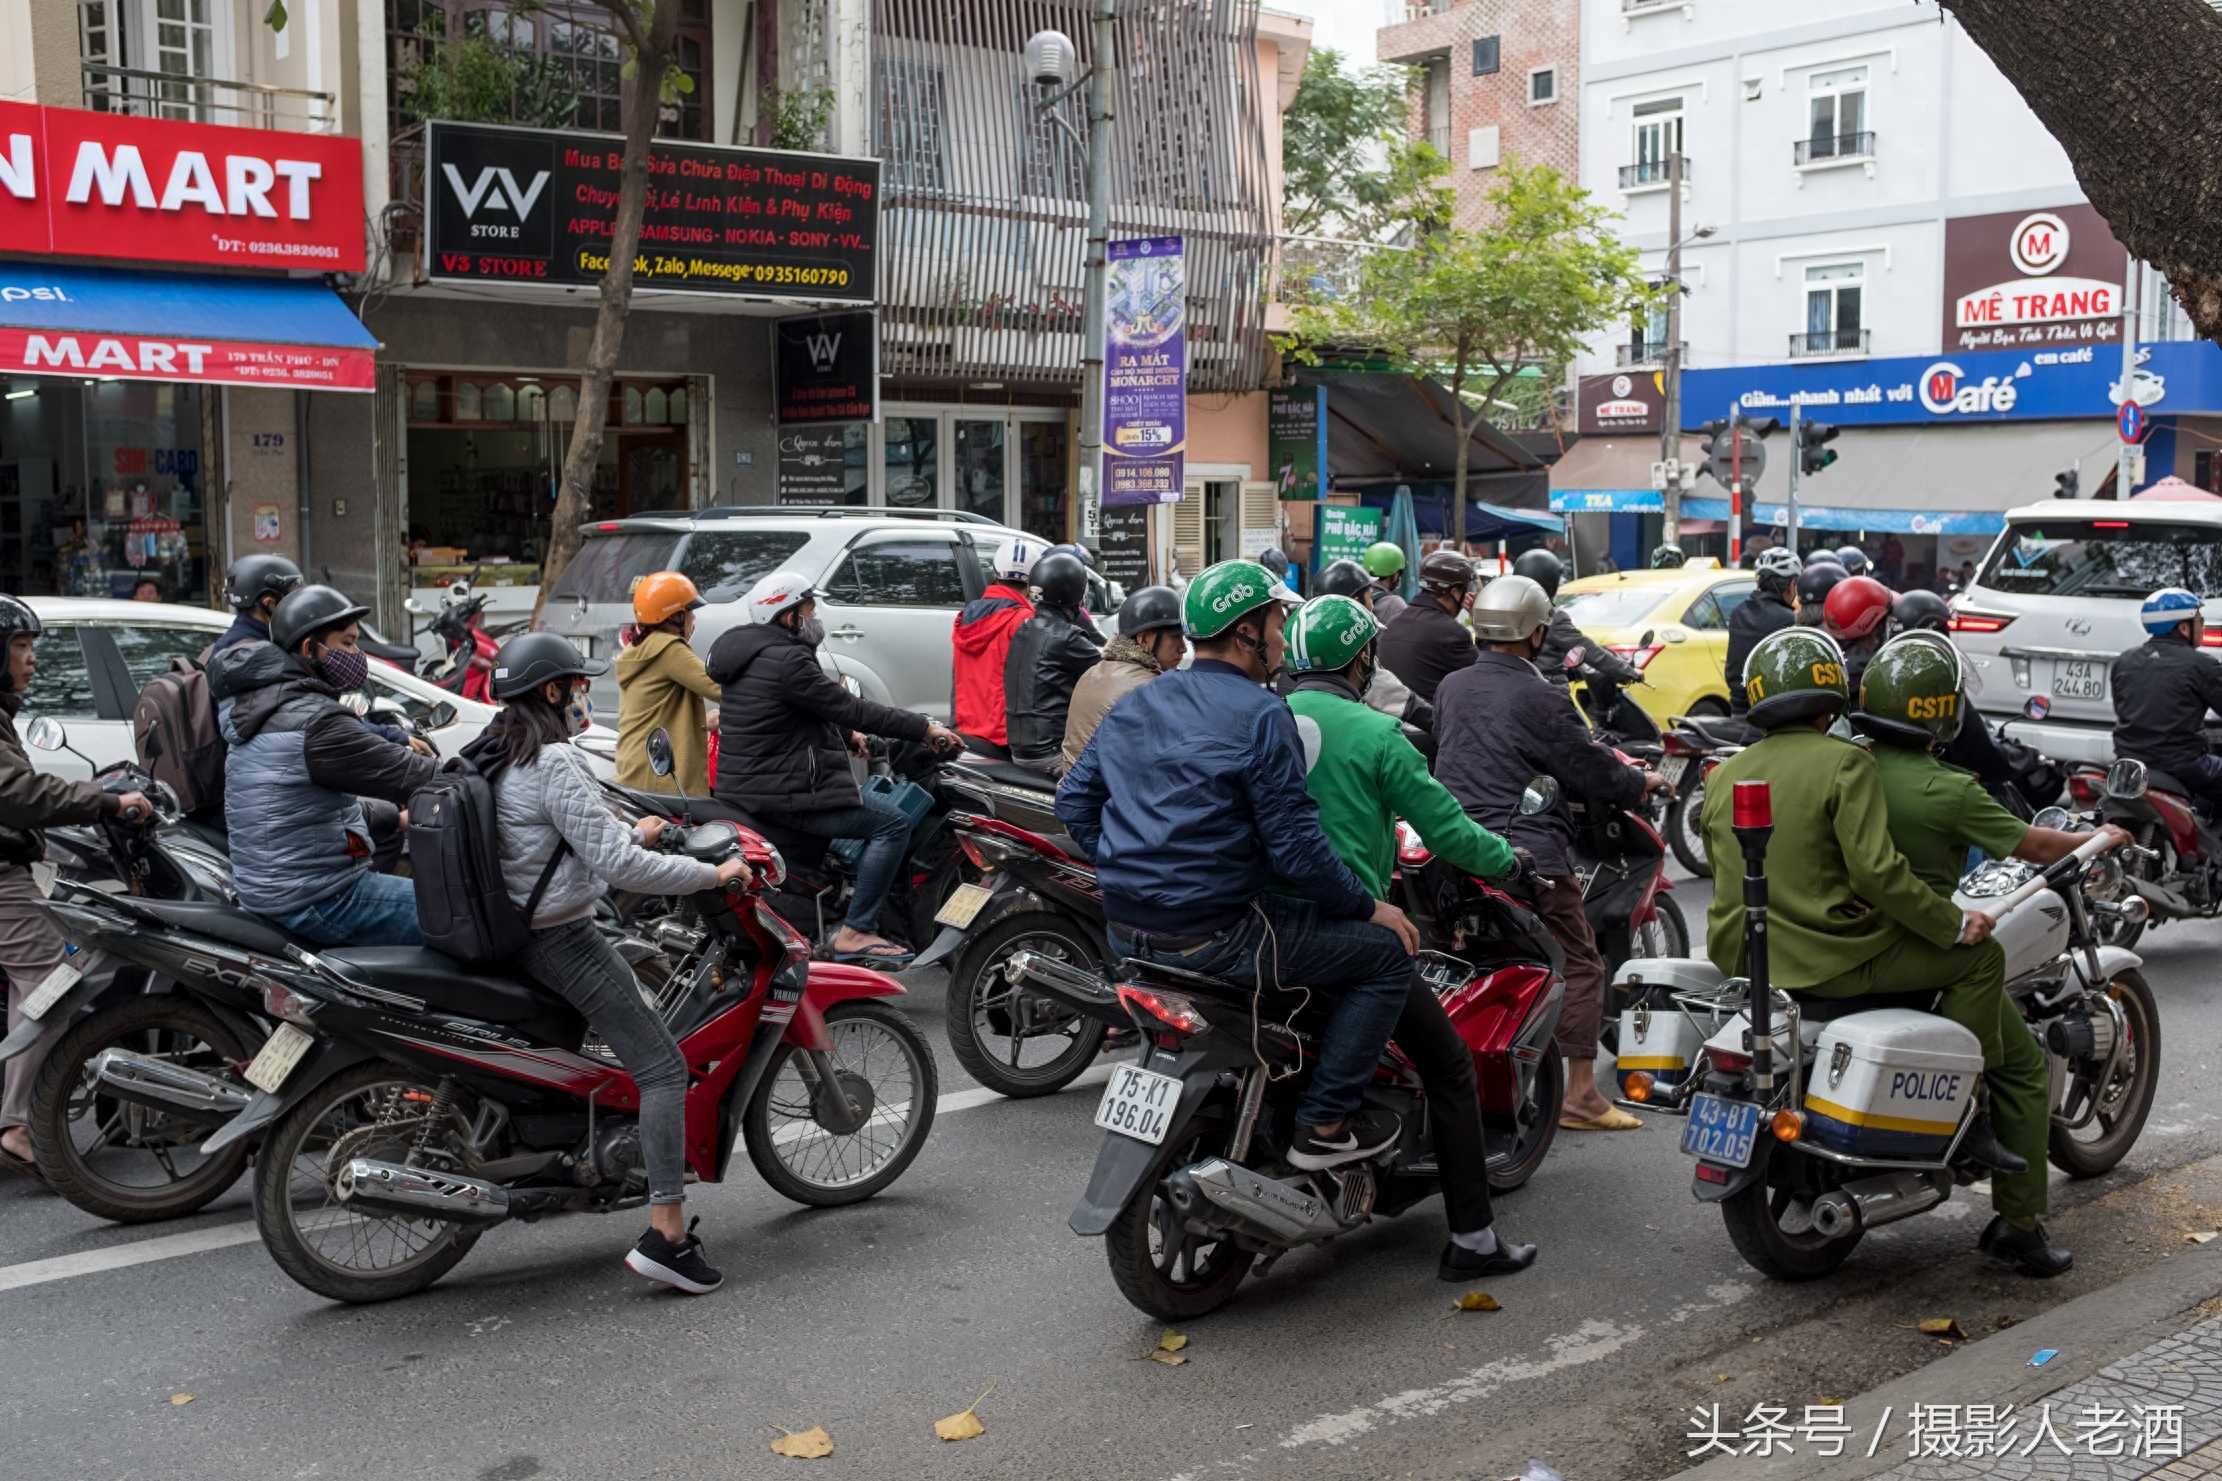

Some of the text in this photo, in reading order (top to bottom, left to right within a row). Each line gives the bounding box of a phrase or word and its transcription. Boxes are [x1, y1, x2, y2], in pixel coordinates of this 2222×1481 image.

[66, 141, 321, 220] MART
[565, 149, 601, 168] Mua
[727, 163, 760, 188] Điện
[765, 167, 806, 193] Thoại
[812, 172, 828, 189] Di
[834, 175, 873, 200] Động
[685, 193, 721, 212] Linh
[726, 195, 760, 219] Kiện
[766, 200, 777, 217] &
[781, 200, 810, 222] Phụ
[817, 202, 852, 224] Kiện
[470, 224, 520, 238] STORE
[726, 229, 776, 246] NOKIA
[789, 231, 831, 248] SONY
[479, 257, 548, 277] STORE
[755, 266, 848, 286] 0935160790
[1964, 289, 2110, 322] MÊ TRANG
[24, 335, 212, 373] MART
[1120, 355, 1138, 367] RA
[2059, 347, 2093, 364] café
[1110, 375, 1180, 387] MONARCHY
[252, 433, 284, 447] 179
[1212, 584, 1254, 613] Grab
[1341, 618, 1369, 646] Grab
[2066, 662, 2092, 679] 43A
[1908, 694, 1956, 719] CSTT
[1890, 1072, 1960, 1101] POLICE
[1104, 1097, 1164, 1138] 196.04
[1686, 1126, 1750, 1161] 702.05
